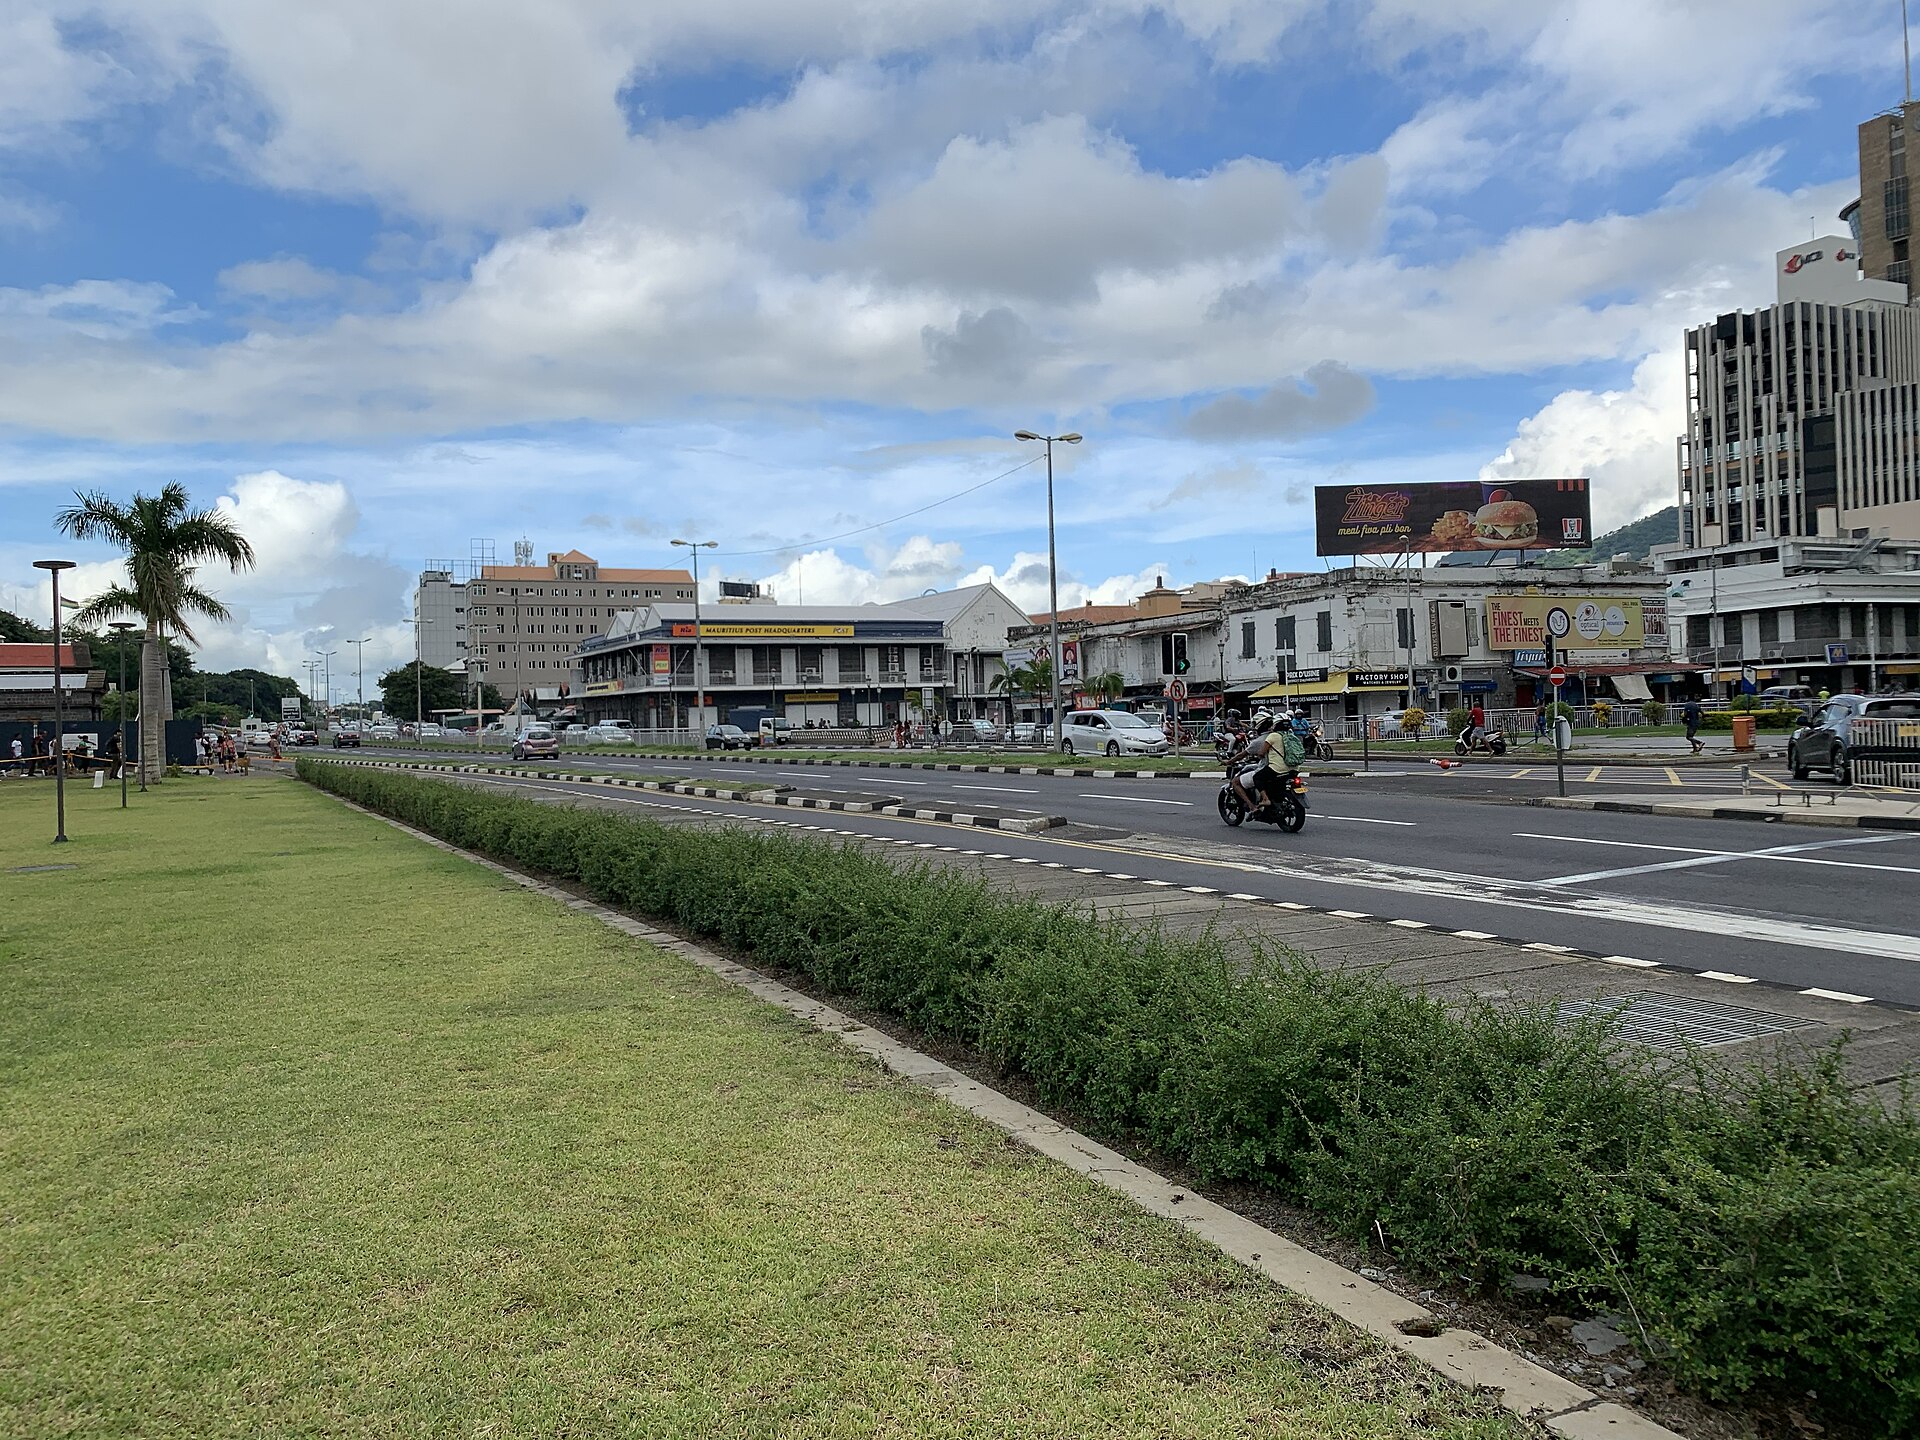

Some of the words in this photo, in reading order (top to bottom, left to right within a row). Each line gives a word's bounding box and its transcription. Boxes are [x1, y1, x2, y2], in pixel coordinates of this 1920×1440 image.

[1341, 486, 1410, 524] Zinger
[1338, 525, 1360, 536] meal
[1360, 524, 1379, 538] fwa
[1379, 524, 1393, 536] pli
[1394, 523, 1412, 533] bon
[1491, 602, 1501, 611] THE
[1492, 611, 1523, 626] FINEST
[1523, 617, 1540, 626] MEETS
[1580, 621, 1599, 629] optical
[1430, 613, 1439, 657] QUIKSILVER
[1493, 627, 1511, 643] THE
[1513, 627, 1544, 643] FINEST
[1298, 669, 1320, 678] D'USINE
